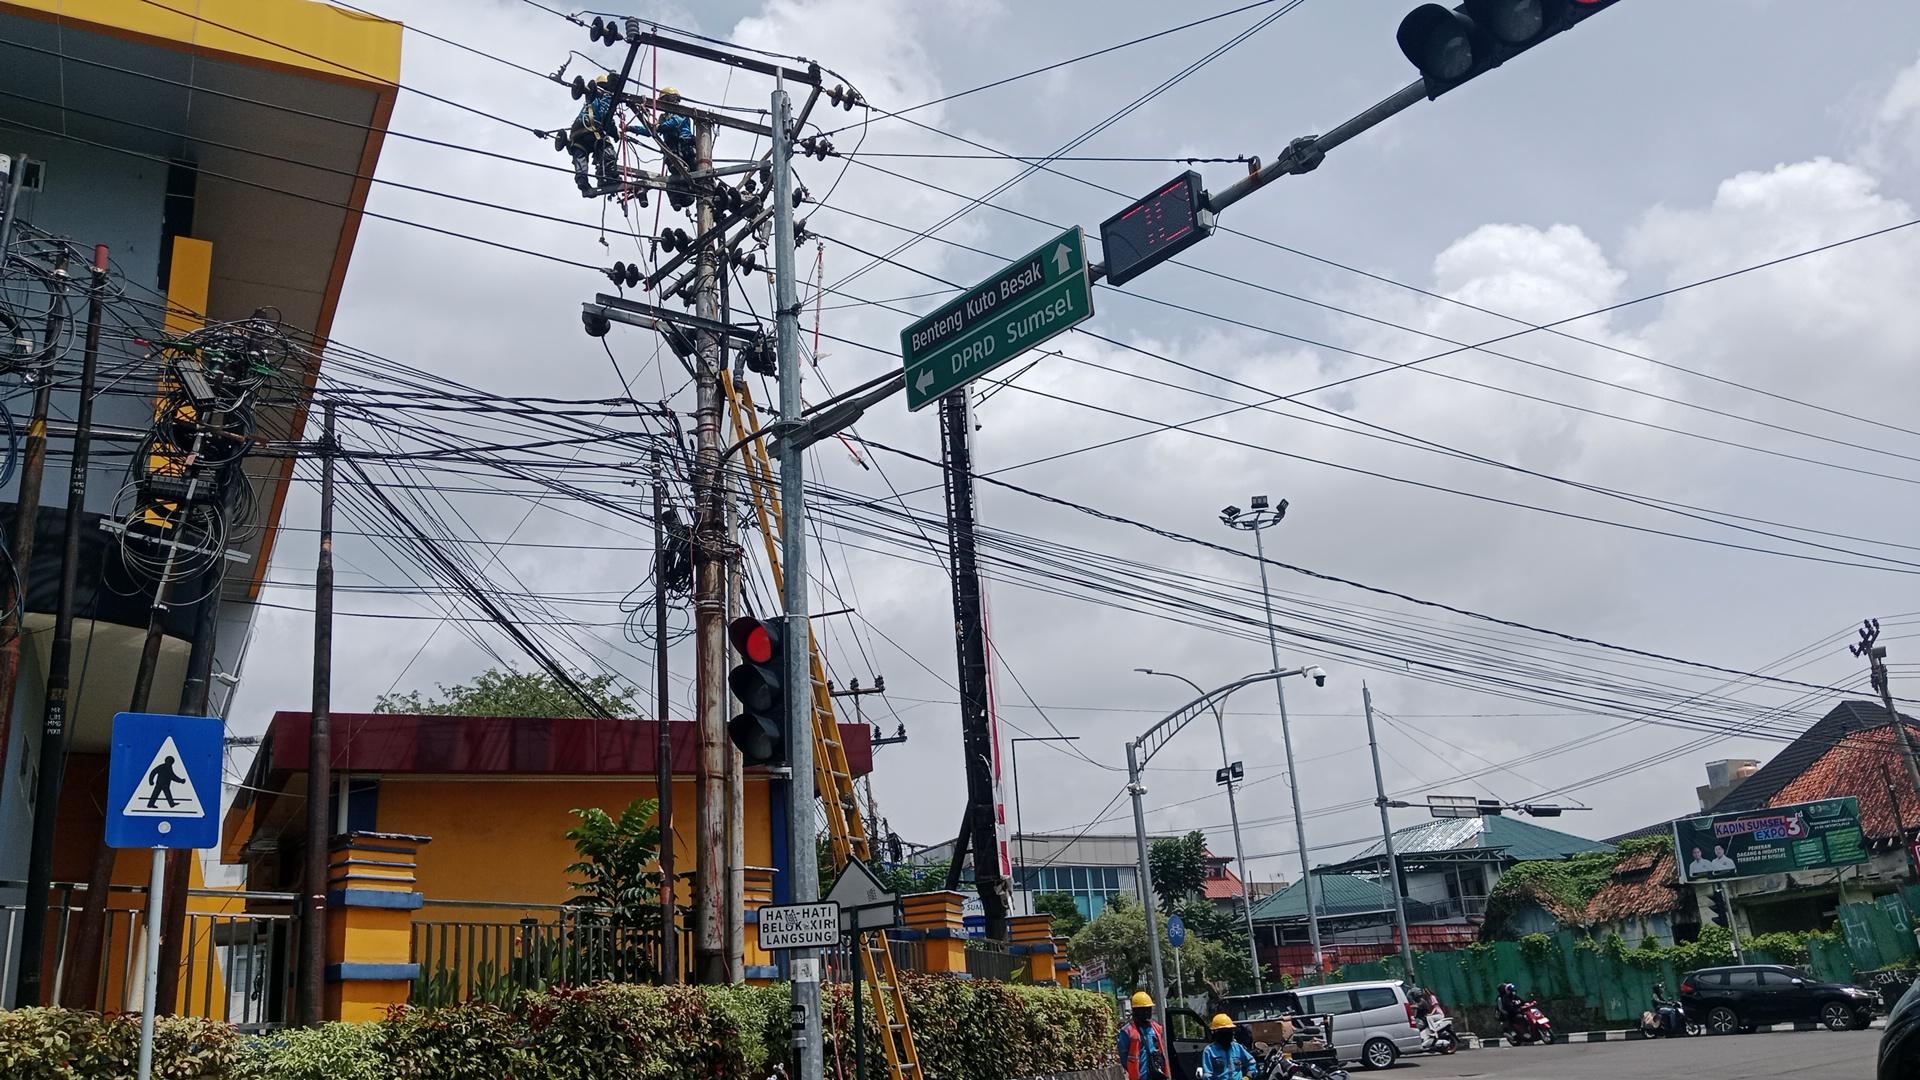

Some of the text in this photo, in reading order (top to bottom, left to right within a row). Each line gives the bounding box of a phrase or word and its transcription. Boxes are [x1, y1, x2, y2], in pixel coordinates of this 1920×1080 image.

[912, 260, 1043, 352] Benteng Kuto Besak
[951, 289, 1074, 375] DPRD Sumsel
[1715, 820, 1745, 836] KADIN
[1747, 818, 1785, 831] SUMSEL
[1755, 827, 1786, 840] EXPO
[762, 919, 836, 933] BELOK KIRI
[766, 931, 832, 945] LANGSUNG
